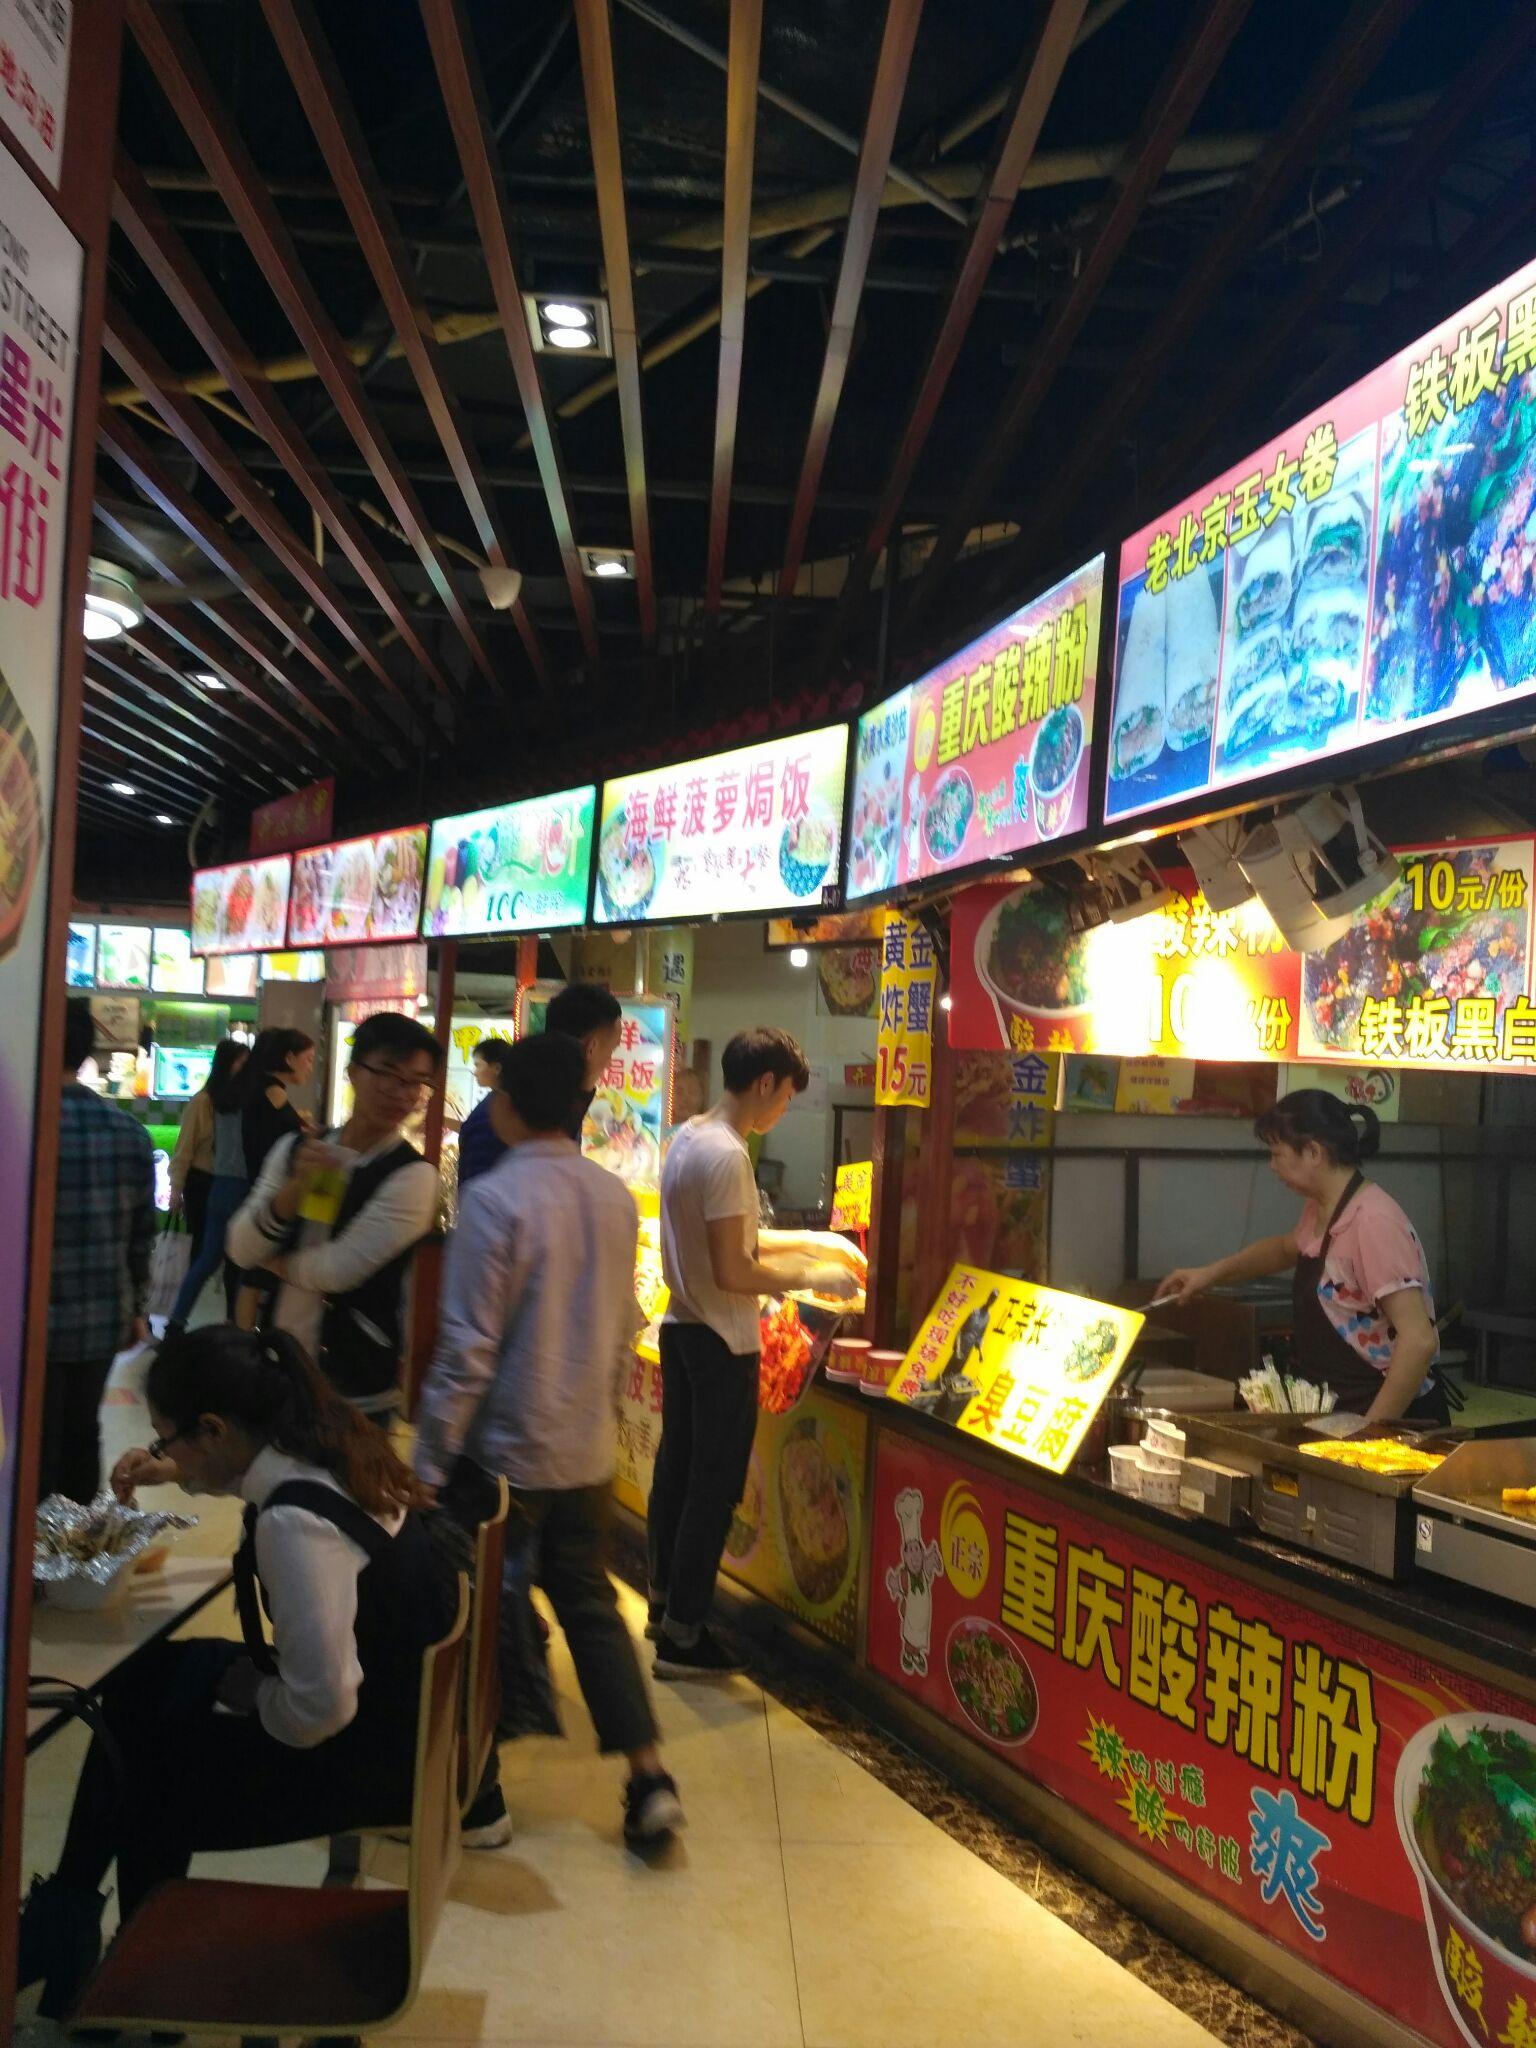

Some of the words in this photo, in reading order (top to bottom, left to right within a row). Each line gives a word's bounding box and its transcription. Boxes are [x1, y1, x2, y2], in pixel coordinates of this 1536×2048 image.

[0, 264, 69, 373] STREET
[1142, 422, 1340, 596] 老北京玉女卷
[936, 598, 1089, 768] 重庆酸辣粉
[623, 752, 812, 846] 海鲜菠萝焗饭
[1407, 860, 1526, 913] 10元/份
[880, 981, 931, 1034] 炸蟹
[879, 1046, 927, 1097] 15元
[968, 1370, 1089, 1462] 臭豆腐
[950, 1535, 984, 1582] 正宗
[999, 1508, 1380, 1825] 重庆酸辣粉
[1133, 1778, 1243, 1886] 酸的舒服
[1249, 1786, 1332, 1942] 爽
